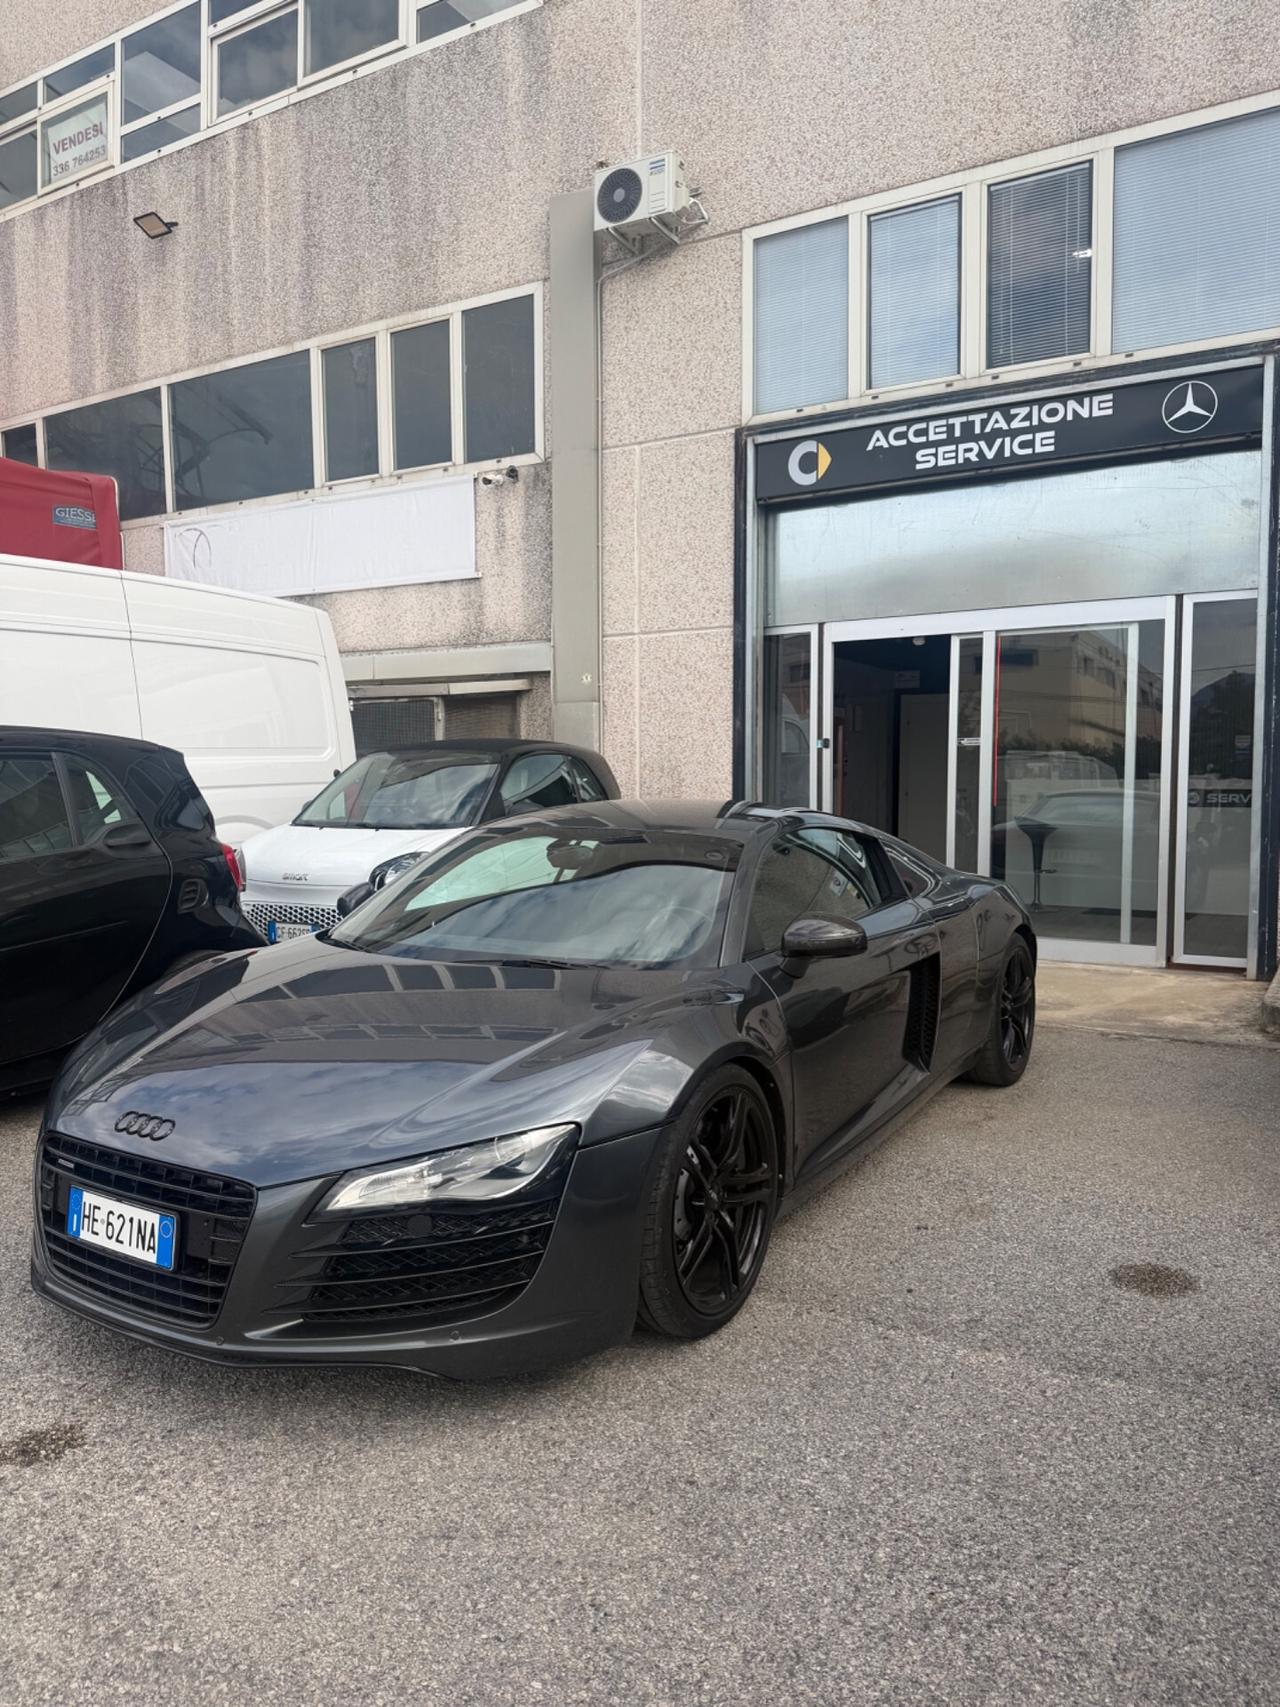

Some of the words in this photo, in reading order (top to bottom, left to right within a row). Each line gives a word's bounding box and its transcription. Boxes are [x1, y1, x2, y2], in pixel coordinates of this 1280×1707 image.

[53, 121, 104, 155] VENDESI
[53, 161, 70, 176] 336
[866, 393, 1114, 451] ACCETTAZIONE
[915, 430, 1056, 470] SERVICE
[82, 1201, 101, 1236] HE
[105, 1210, 156, 1254] 621NA
